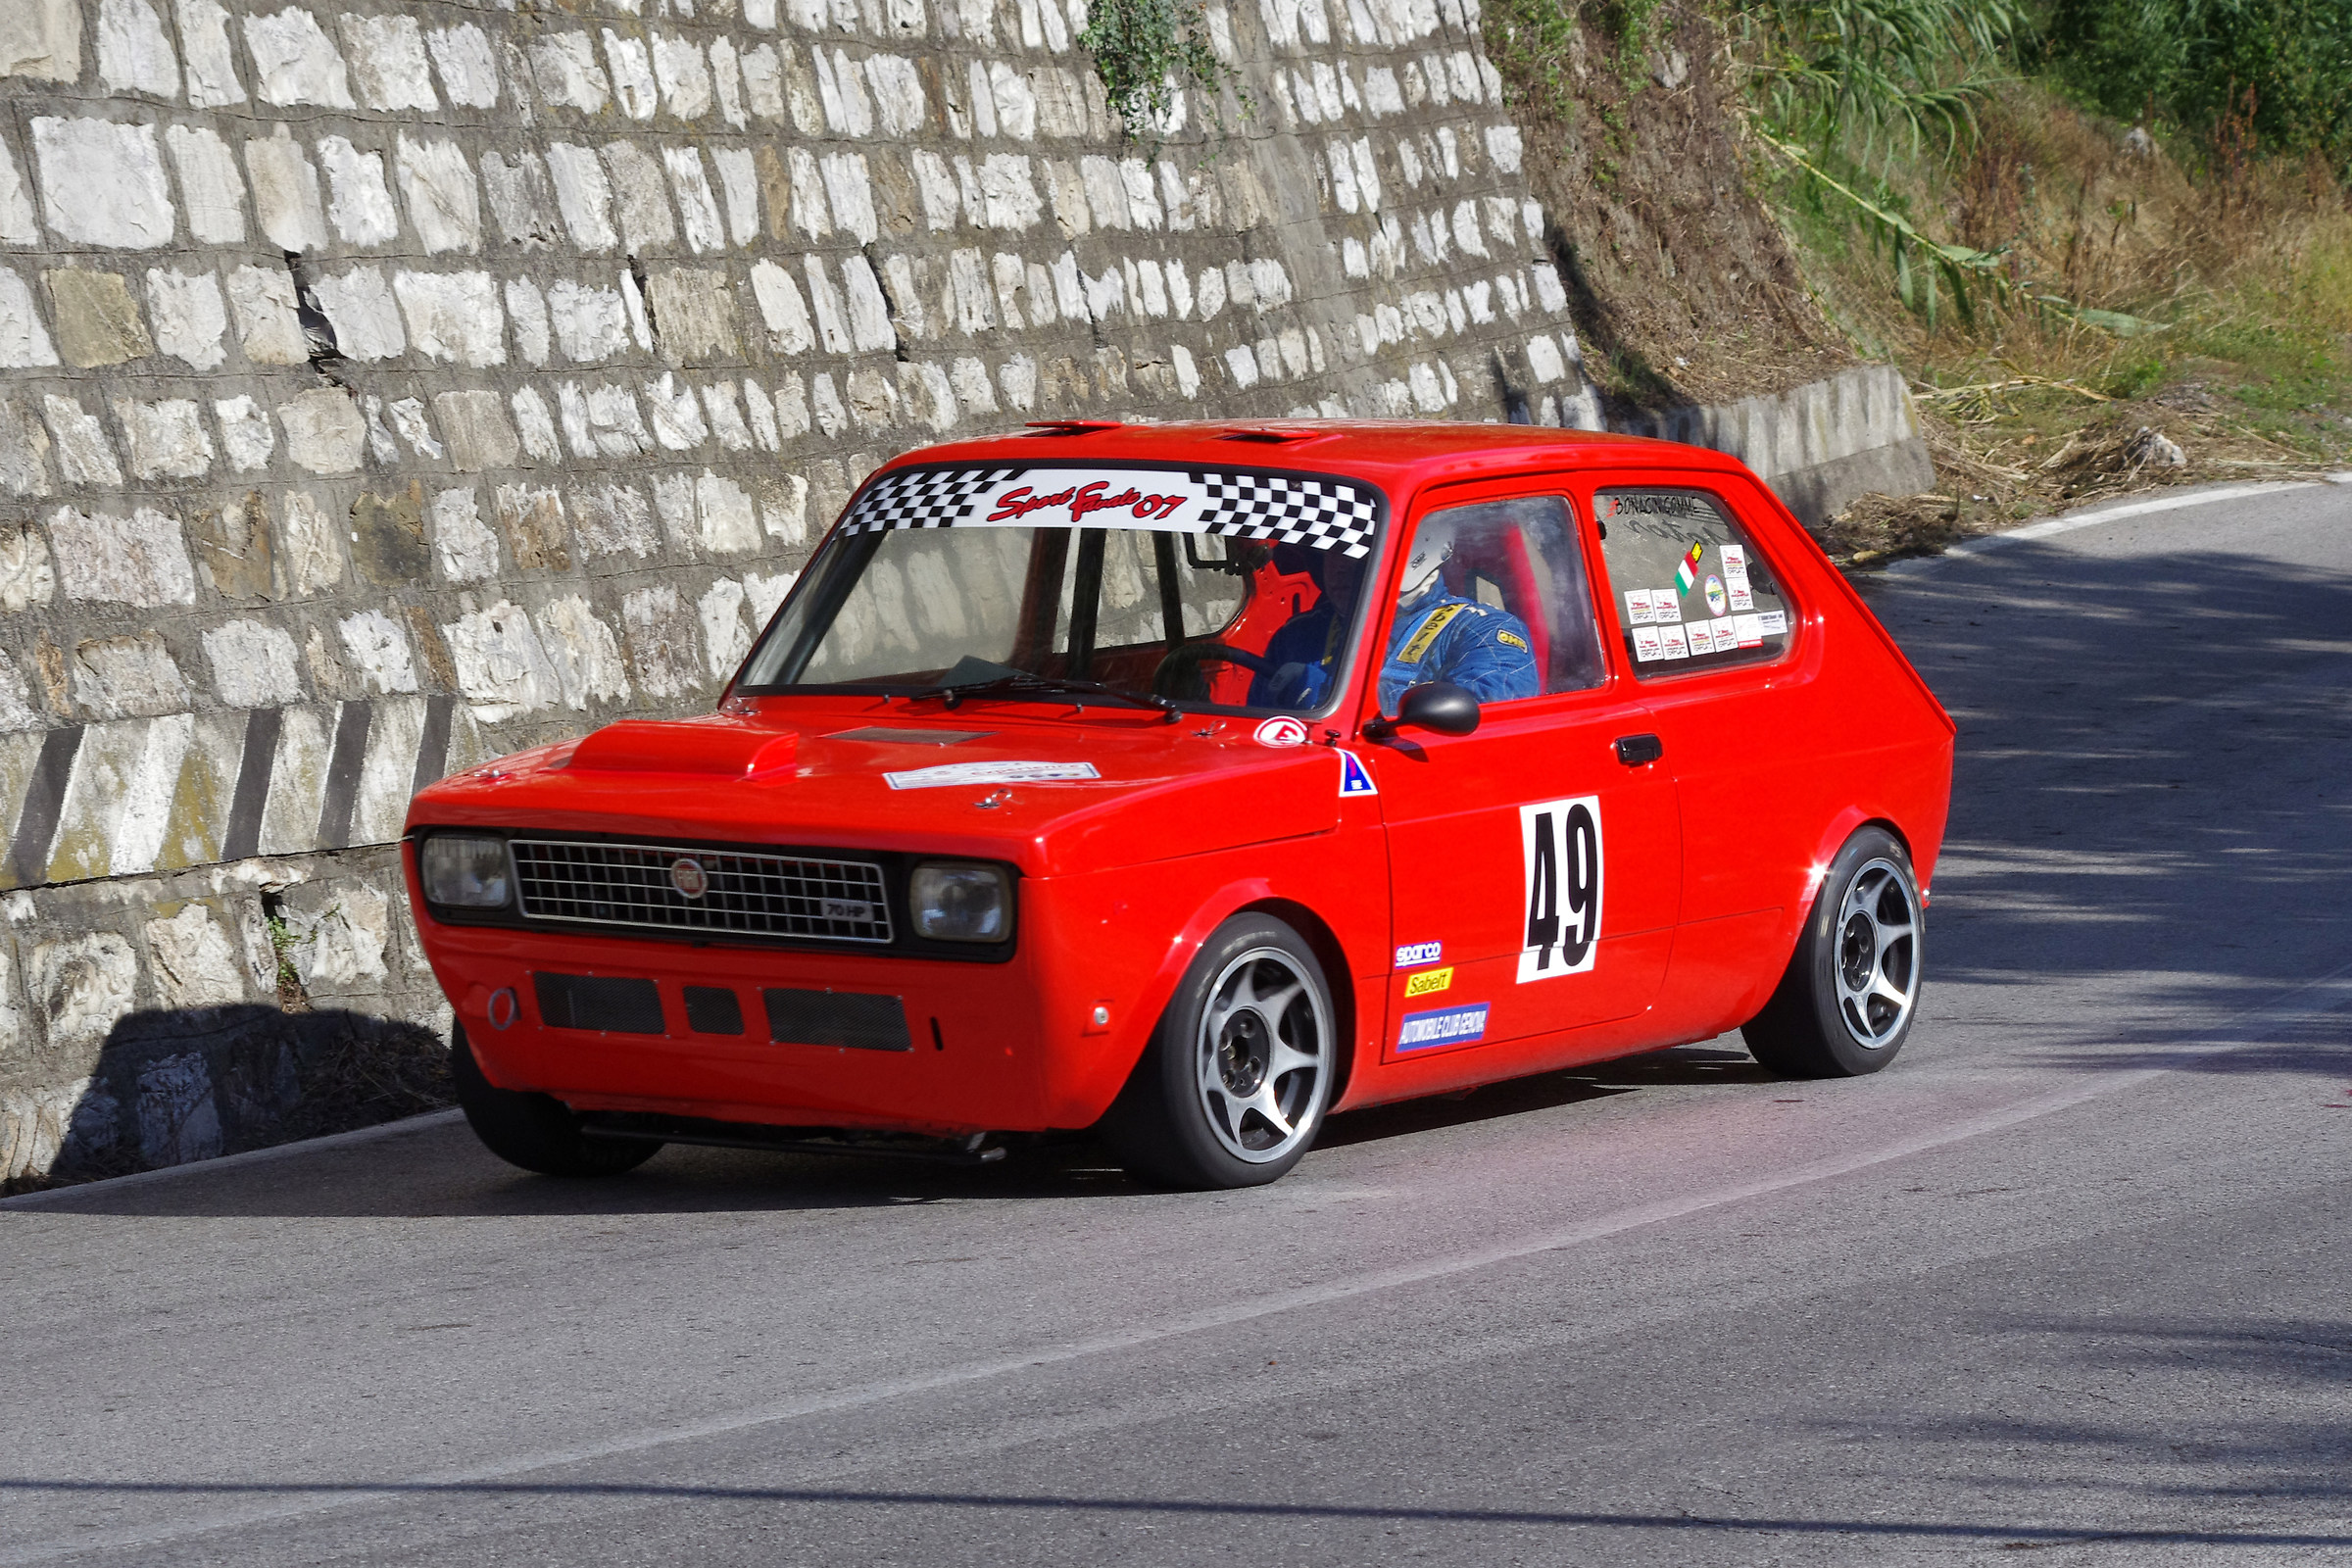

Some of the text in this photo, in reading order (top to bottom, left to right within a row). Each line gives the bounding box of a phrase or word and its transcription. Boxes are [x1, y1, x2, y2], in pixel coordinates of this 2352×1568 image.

[986, 486, 1076, 521] Sport
[1132, 493, 1188, 520] 07
[1527, 804, 1598, 970] 49
[1396, 942, 1442, 966] sparco
[1409, 971, 1447, 995] Sabelt
